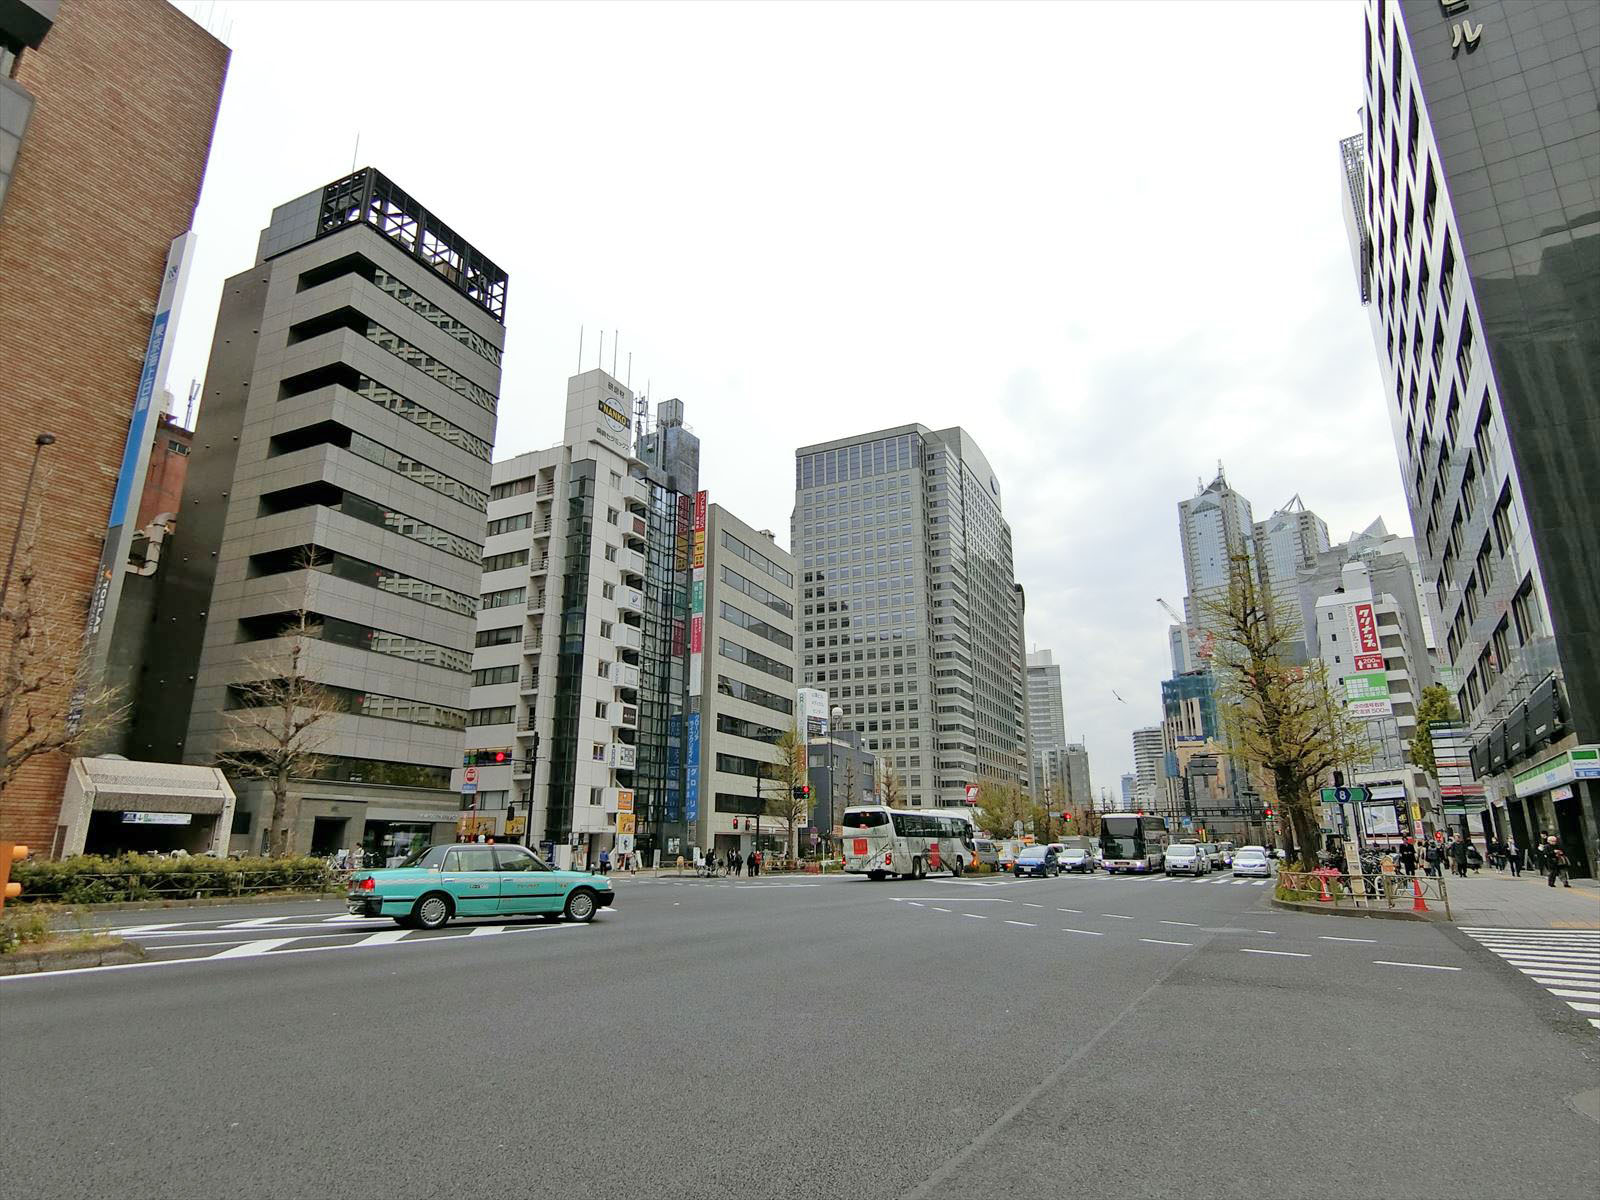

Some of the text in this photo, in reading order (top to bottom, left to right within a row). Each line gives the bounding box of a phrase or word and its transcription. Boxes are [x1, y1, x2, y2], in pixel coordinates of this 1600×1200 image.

[602, 403, 627, 426] NANKO
[92, 580, 111, 634] TOCLAS
[1359, 609, 1377, 648] クリナップ
[1339, 790, 1346, 800] 8
